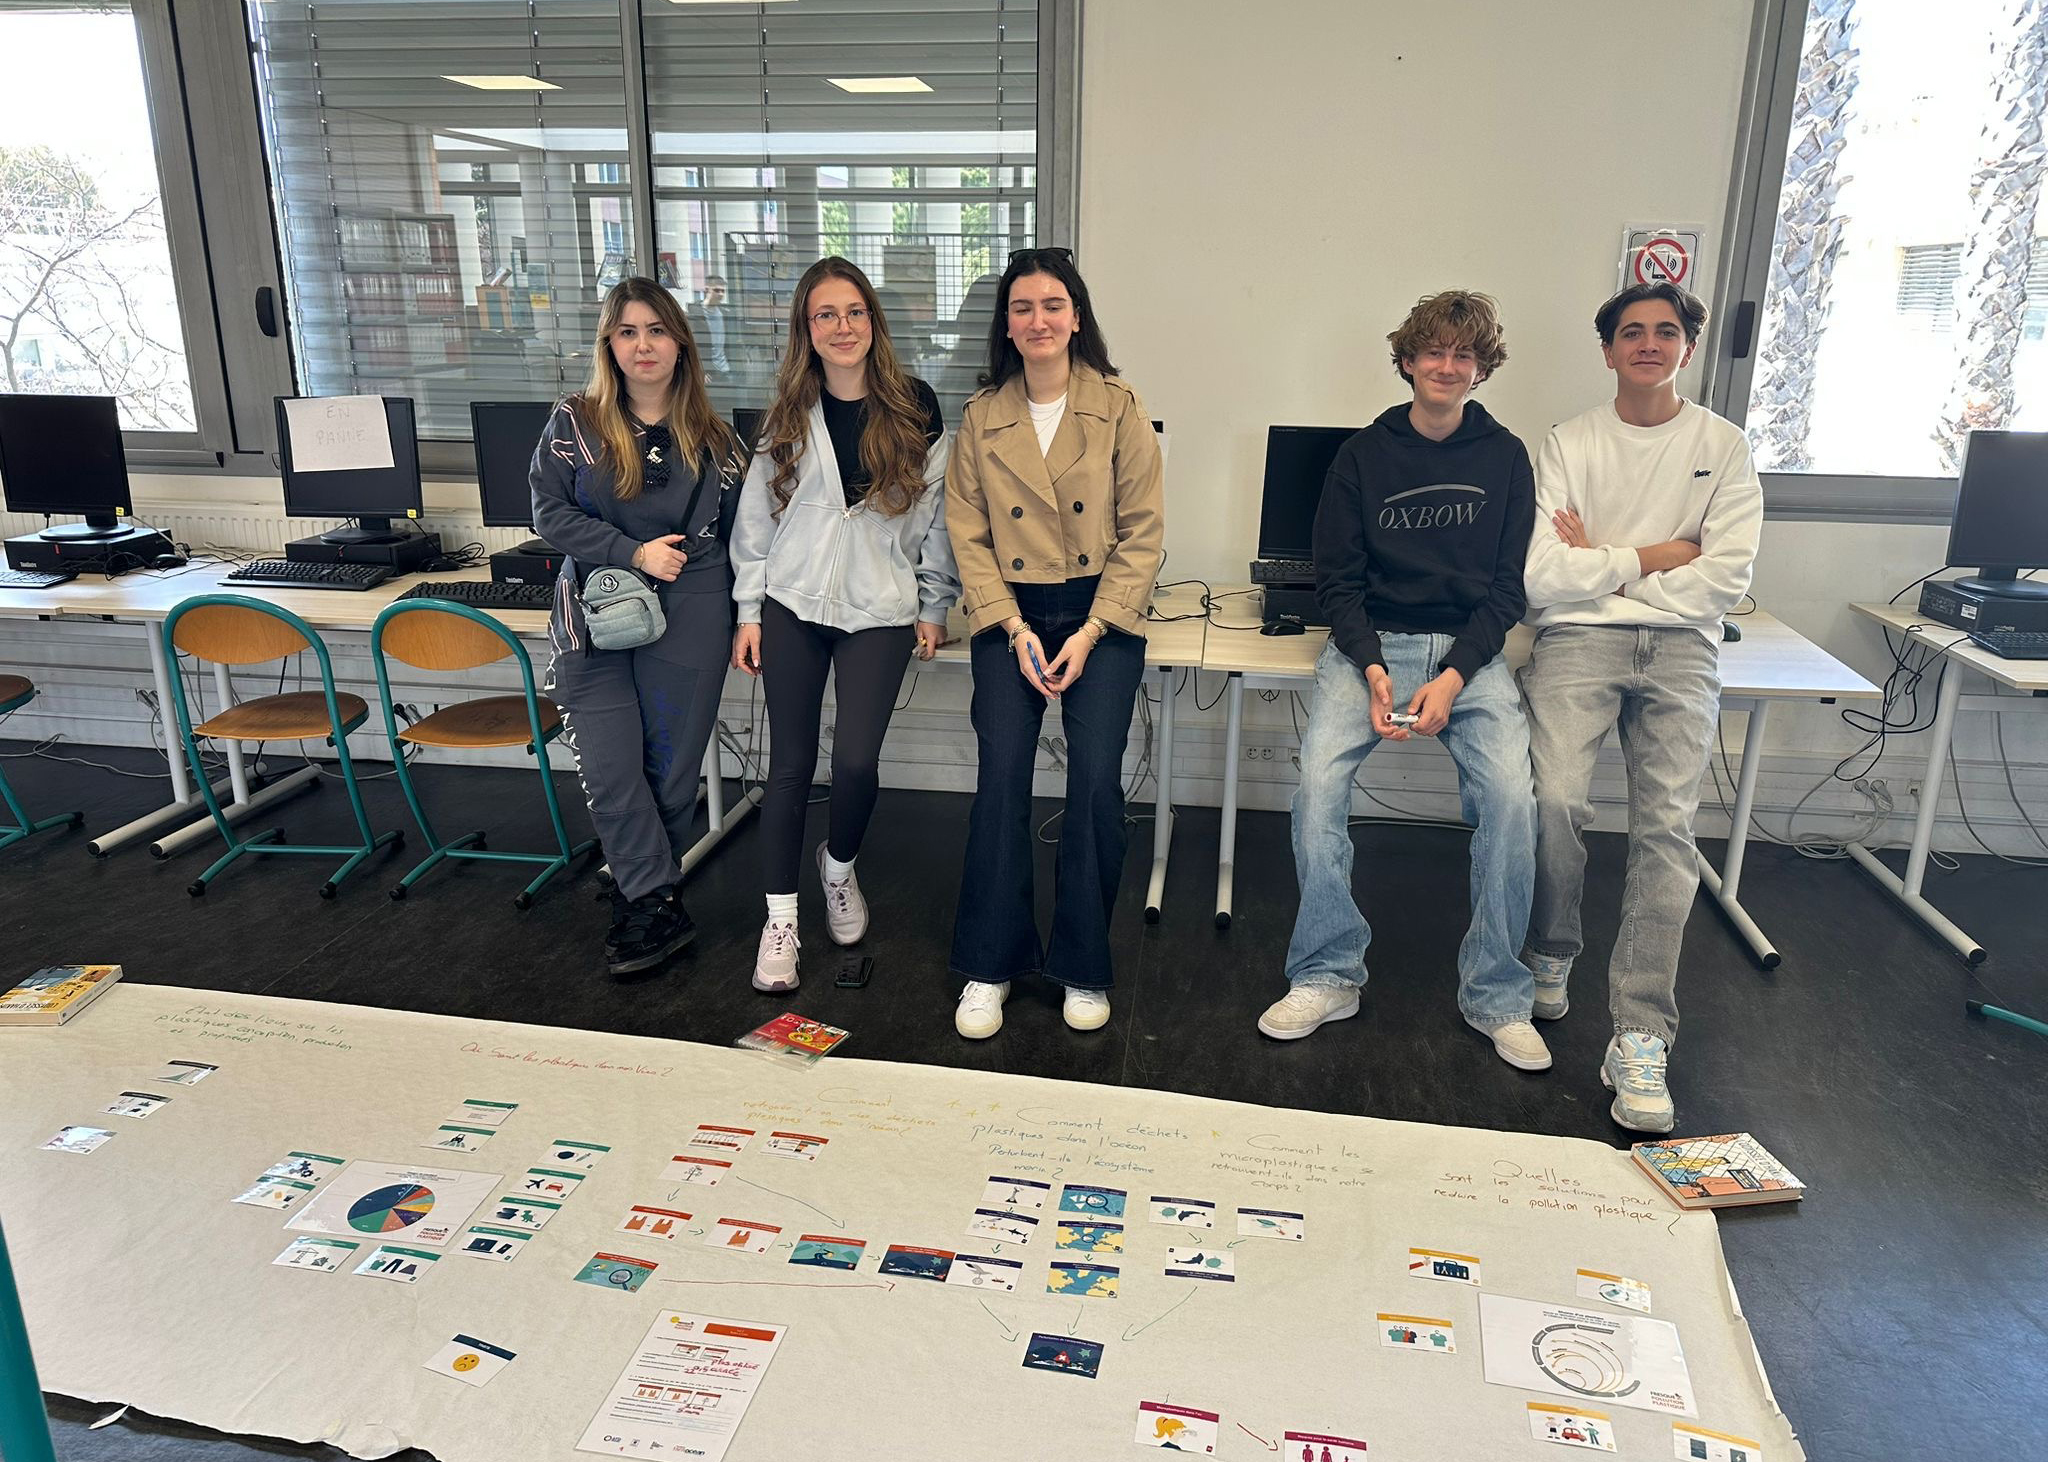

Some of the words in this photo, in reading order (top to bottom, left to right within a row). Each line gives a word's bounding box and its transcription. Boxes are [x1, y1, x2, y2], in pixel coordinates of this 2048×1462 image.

[327, 405, 350, 419] EN
[316, 429, 366, 445] PANNE
[1378, 501, 1487, 529] OXBOW
[817, 1087, 892, 1107] Comment
[1016, 1106, 1104, 1130] Comment
[1126, 1123, 1190, 1140] déchets
[971, 1124, 1044, 1141] plastiques
[1056, 1131, 1087, 1144] dans
[1247, 1133, 1323, 1155] Comment
[1341, 1145, 1359, 1159] les
[1014, 1164, 1045, 1173] marin
[1220, 1151, 1339, 1173] microplastiques
[1361, 1167, 1375, 1175] se
[1492, 1159, 1582, 1187] Quelles
[1251, 1180, 1289, 1191] corps
[1305, 1174, 1327, 1184] dans
[1339, 1178, 1366, 1187] notre
[1493, 1178, 1509, 1186] les
[1537, 1184, 1606, 1198] solutions
[1620, 1195, 1656, 1208] pour
[1498, 1195, 1509, 1204] la
[1529, 1199, 1578, 1212] pollution
